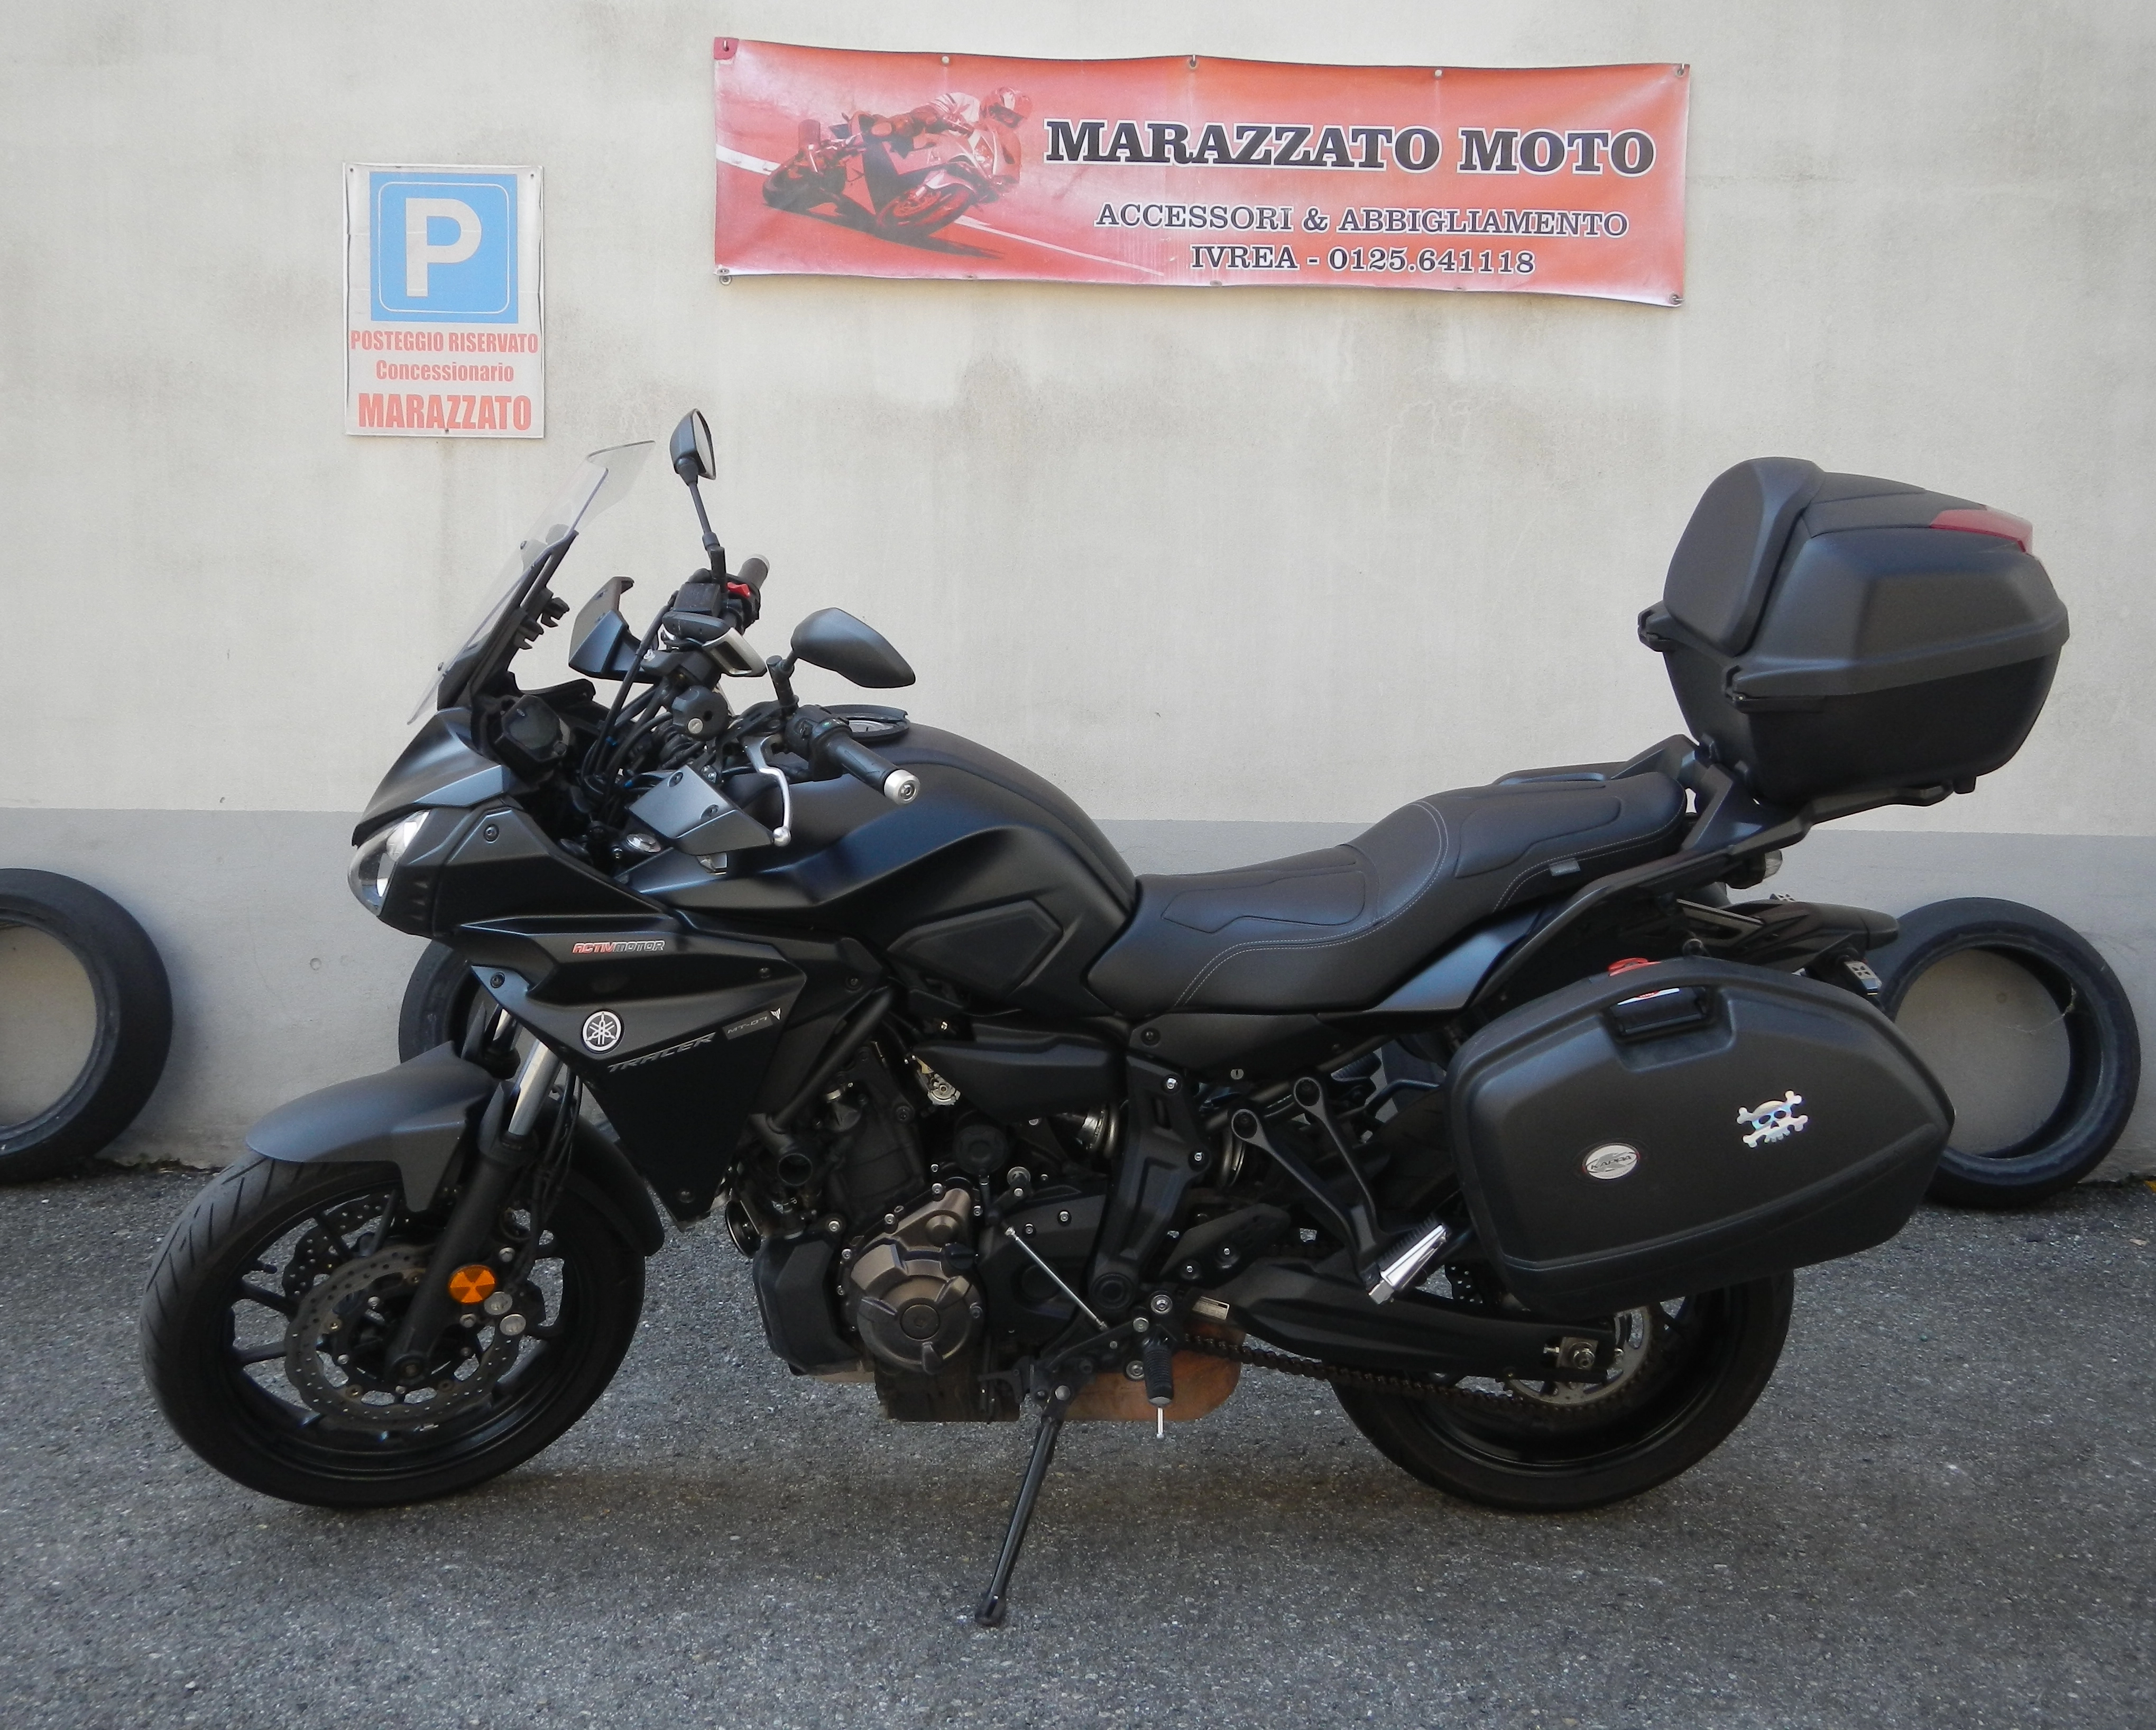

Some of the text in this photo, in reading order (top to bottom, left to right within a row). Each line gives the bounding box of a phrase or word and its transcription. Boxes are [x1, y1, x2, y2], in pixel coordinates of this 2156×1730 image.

[1044, 119, 1656, 177] MARAZZATO MOTO
[1094, 203, 1629, 238] ACCESSORI & ABBIGLIAMENTO
[406, 197, 482, 297] P
[1190, 244, 1300, 270] IVREA
[1328, 245, 1536, 275] 0125.641118
[351, 330, 539, 354] POSTEGGIO RISERVATO
[376, 360, 514, 382] Concessionario
[358, 393, 532, 431] MARAZZATO
[727, 1016, 768, 1034] MT-07
[607, 1032, 716, 1073] TRACER
